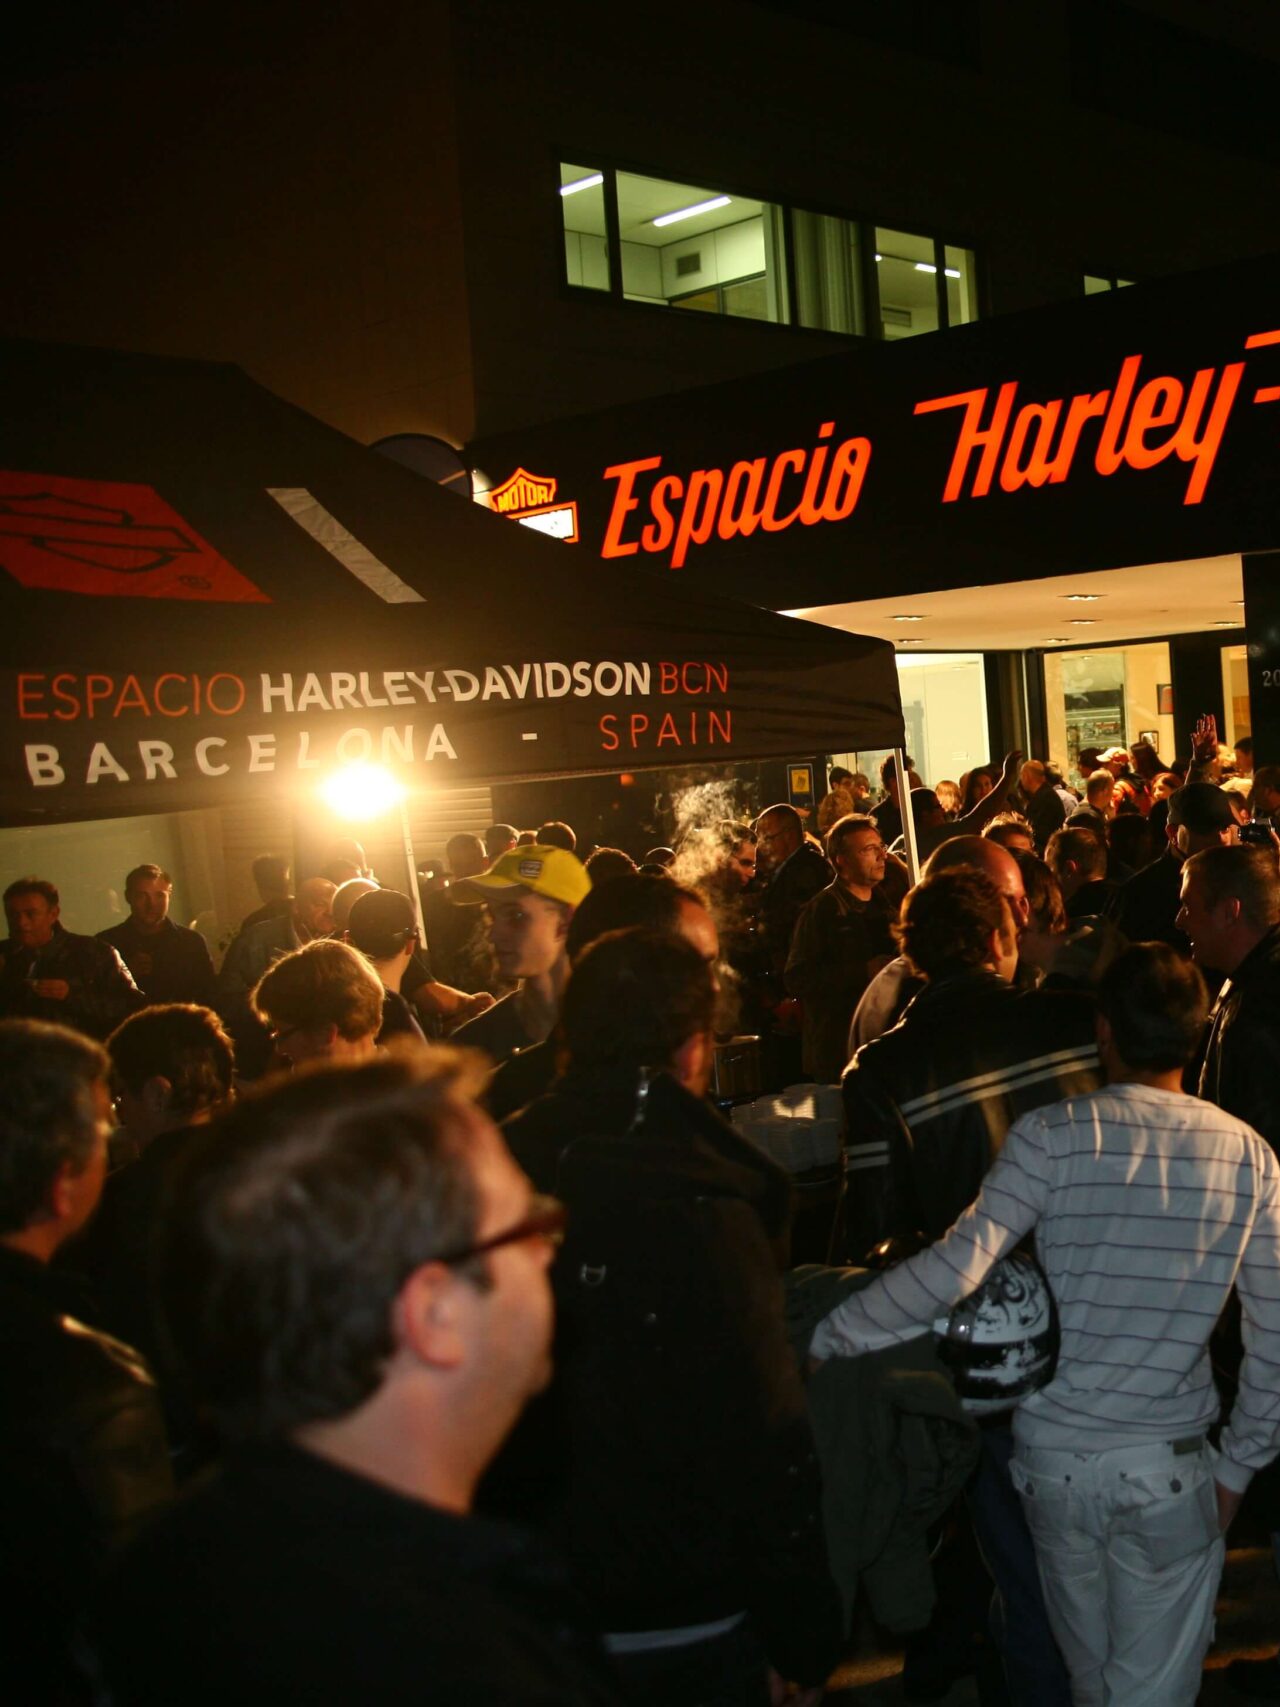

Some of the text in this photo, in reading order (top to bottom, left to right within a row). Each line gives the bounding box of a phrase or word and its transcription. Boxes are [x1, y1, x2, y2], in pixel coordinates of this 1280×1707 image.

[497, 476, 549, 513] MOTOR
[601, 422, 872, 569] Espacio
[17, 661, 729, 720] ESPACIO HARLEY-DAVIDSON BCN
[24, 723, 458, 786] BARCELONA
[599, 711, 732, 750] SPAIN
